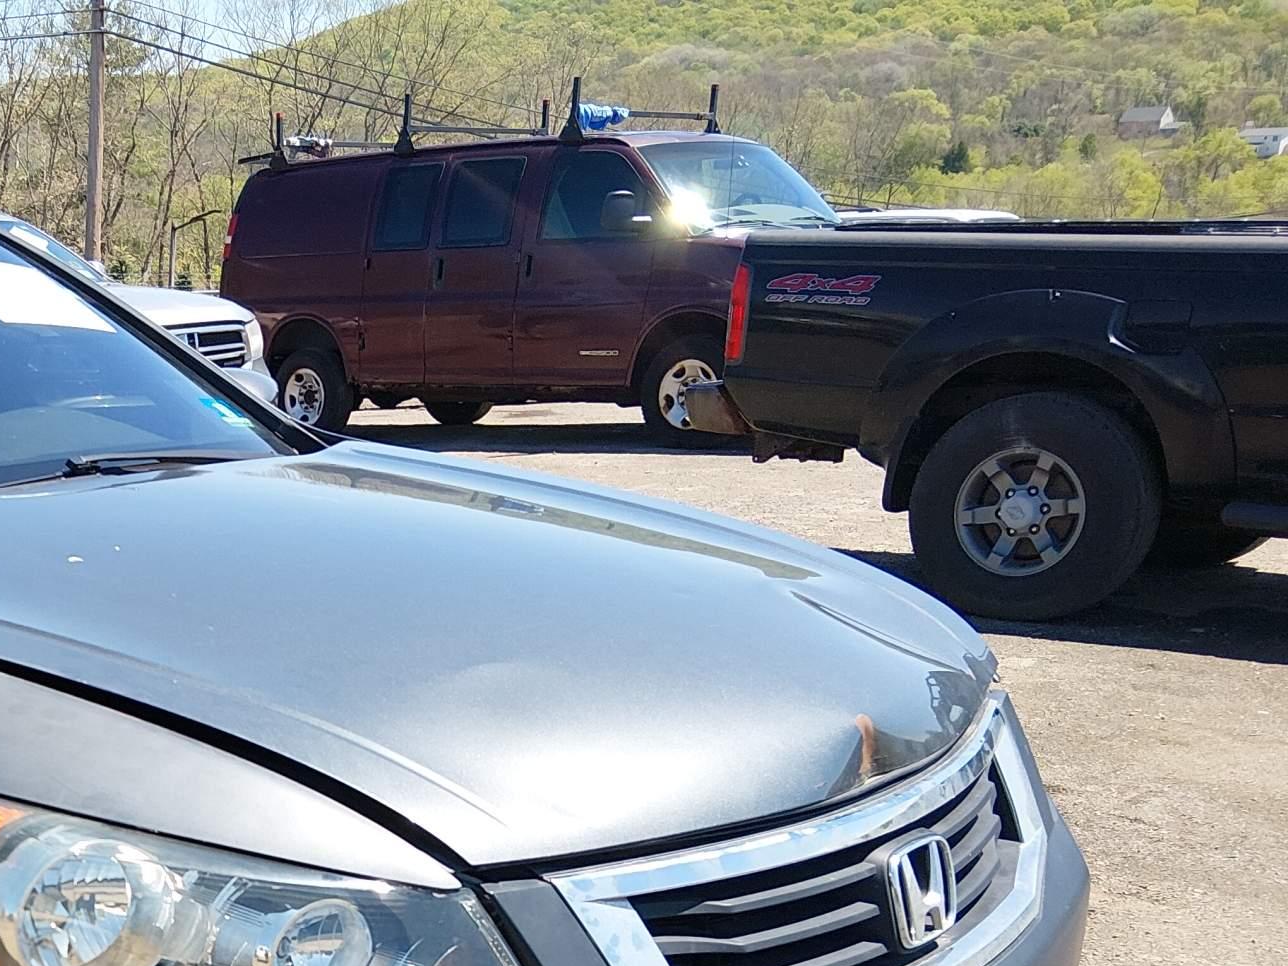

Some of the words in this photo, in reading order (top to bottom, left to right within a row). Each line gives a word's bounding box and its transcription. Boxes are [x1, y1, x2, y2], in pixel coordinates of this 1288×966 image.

[766, 272, 882, 295] 4x4
[764, 293, 809, 303] OFF
[808, 295, 871, 305] ROAD
